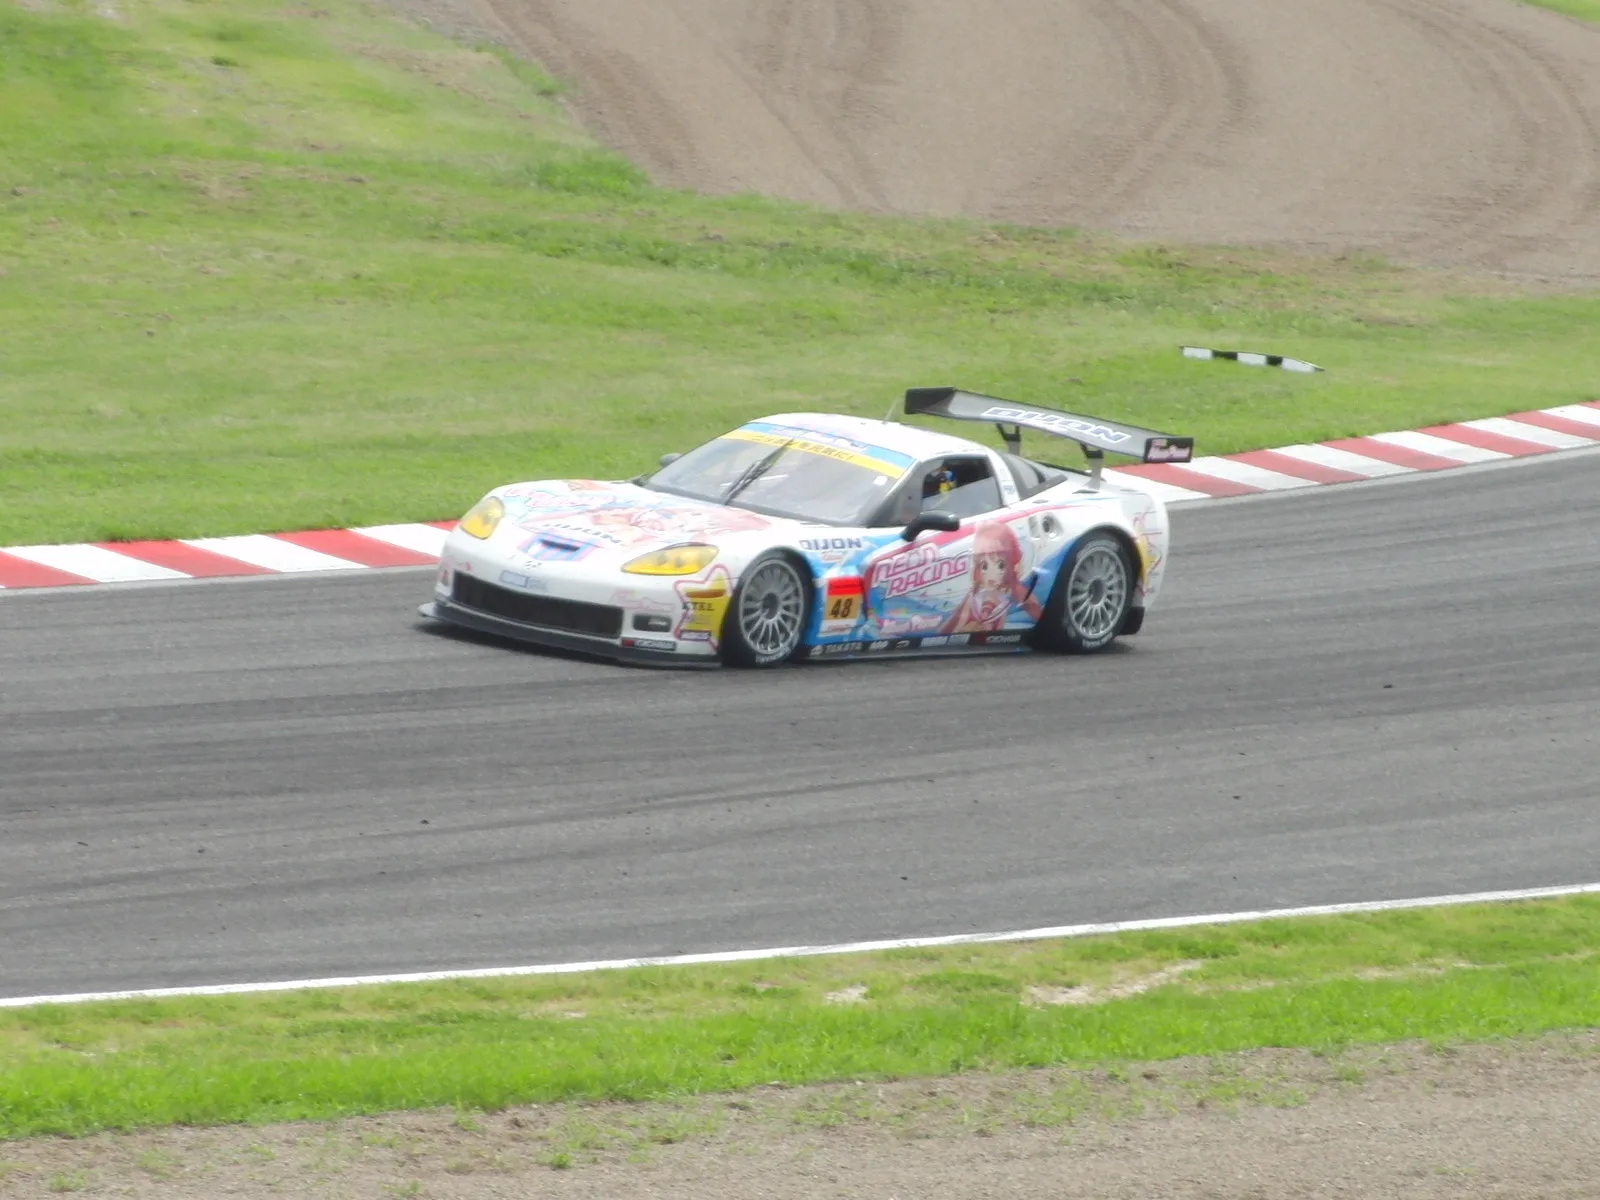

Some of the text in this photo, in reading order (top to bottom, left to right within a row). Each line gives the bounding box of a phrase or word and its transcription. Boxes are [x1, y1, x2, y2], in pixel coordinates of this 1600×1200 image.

[980, 406, 1132, 444] DIJON
[799, 537, 862, 551] DIJON
[886, 554, 970, 598] RACING
[829, 597, 853, 619] 48
